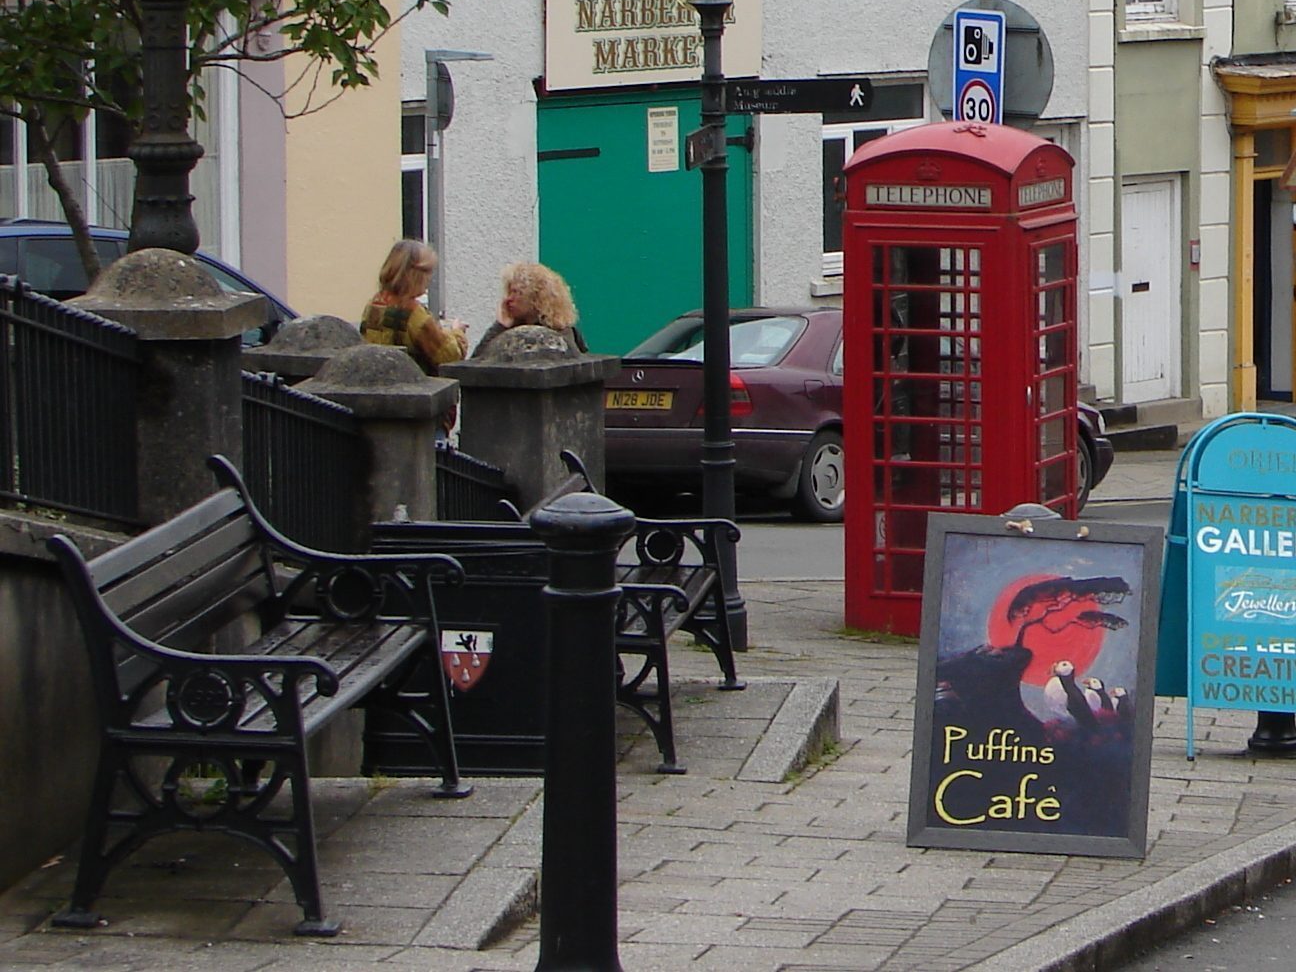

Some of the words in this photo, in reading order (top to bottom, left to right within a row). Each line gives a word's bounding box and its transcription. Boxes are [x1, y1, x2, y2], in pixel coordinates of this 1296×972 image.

[592, 33, 706, 74] MARKE
[965, 97, 990, 122] 30
[872, 186, 989, 205] TELEPHONE
[1020, 180, 1064, 205] TELEPHONE
[943, 725, 1055, 765] Puffins
